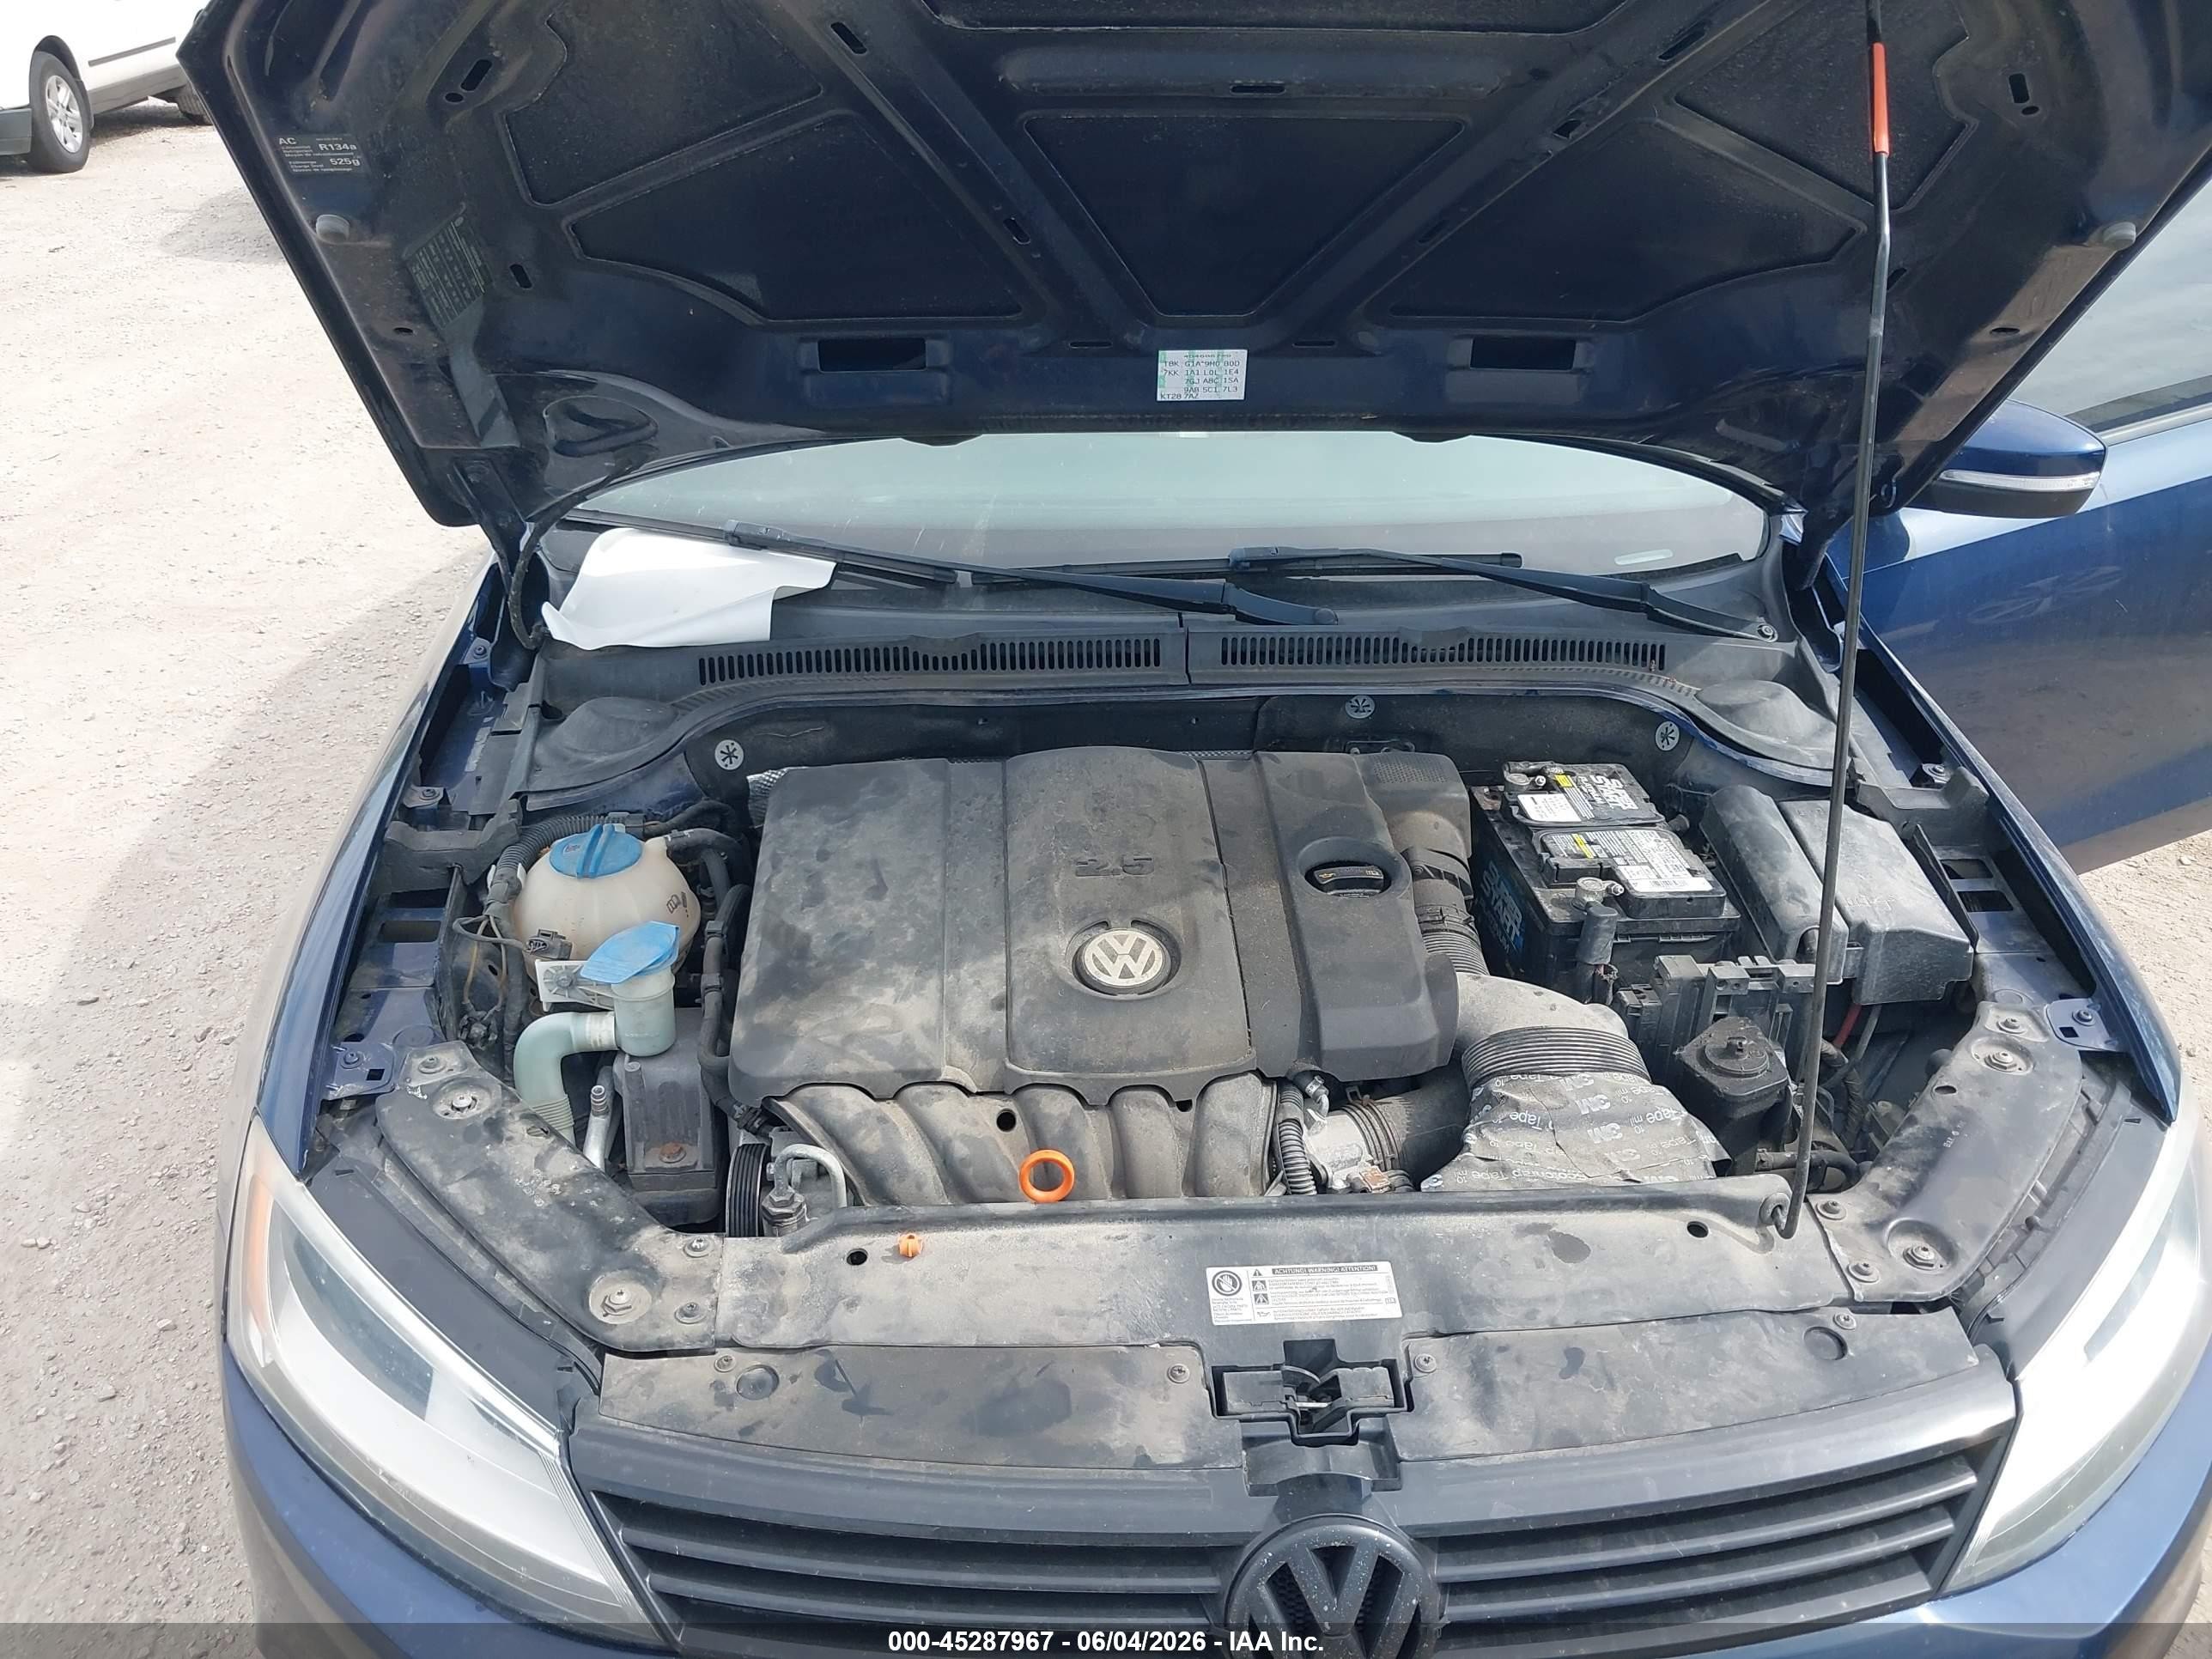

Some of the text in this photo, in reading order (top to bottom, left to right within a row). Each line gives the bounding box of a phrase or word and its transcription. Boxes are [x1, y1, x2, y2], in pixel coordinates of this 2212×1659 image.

[330, 157, 361, 167] 525g
[1575, 1094, 1611, 1115] 3M
[1509, 1110, 1543, 1131] Tape
[1587, 1122, 1623, 1144] 3M
[1471, 1170, 1509, 1182] Tape
